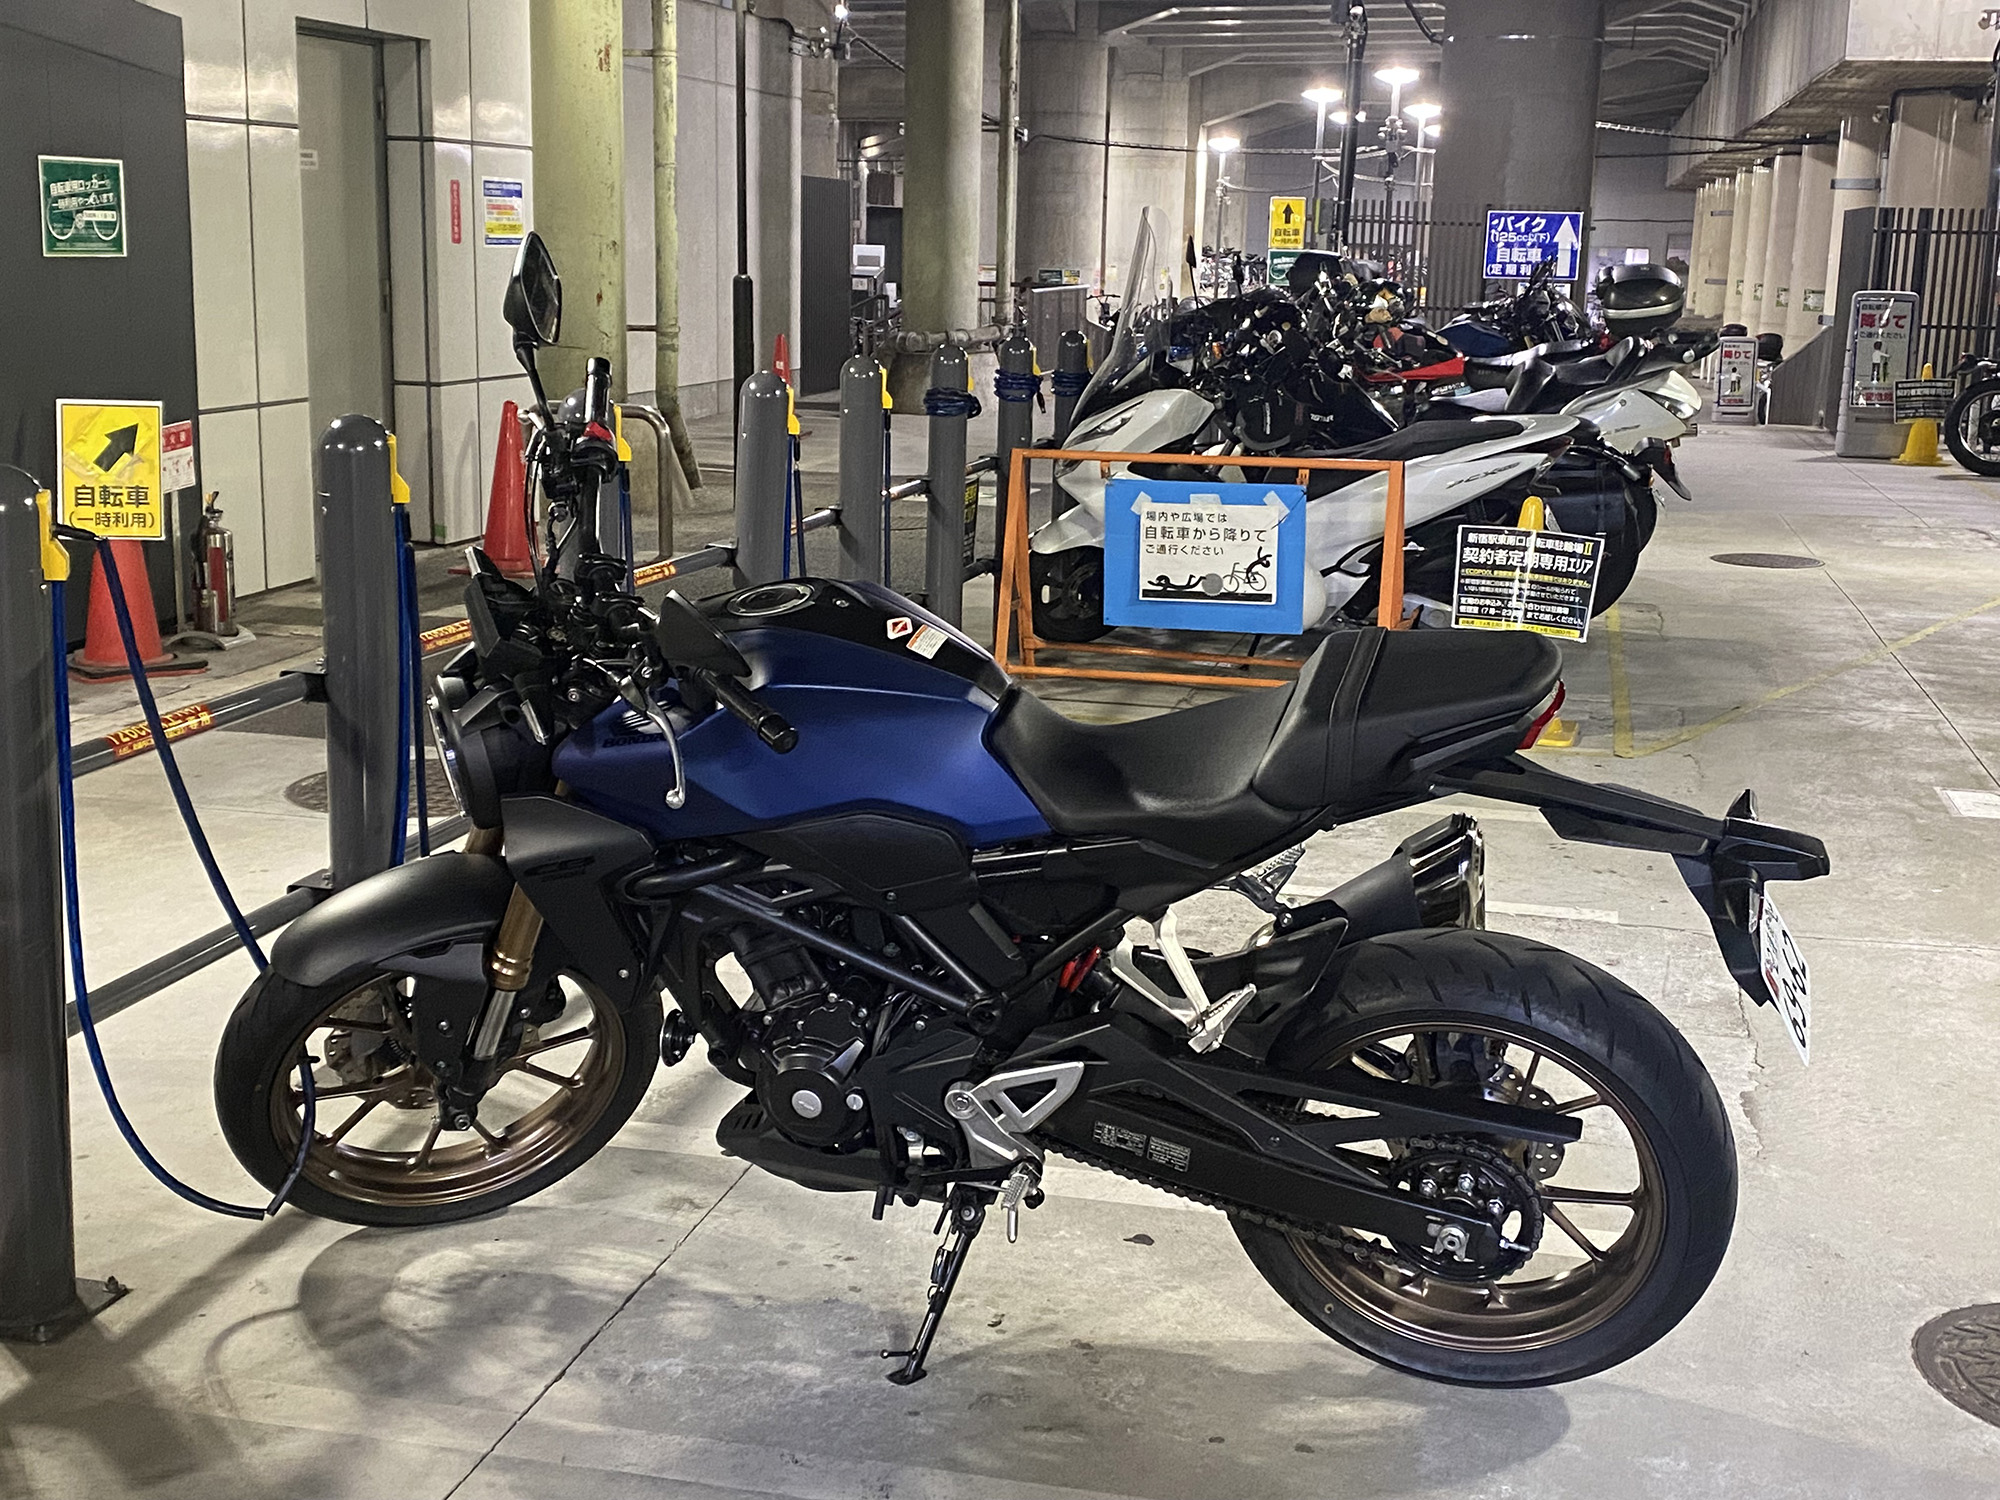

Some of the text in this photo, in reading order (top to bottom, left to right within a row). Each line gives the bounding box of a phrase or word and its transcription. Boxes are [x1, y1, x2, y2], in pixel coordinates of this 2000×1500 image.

[1496, 246, 1542, 263] 自転車
[1861, 313, 1907, 329] 降りて
[74, 485, 150, 508] 自転車
[69, 511, 155, 528] (一時利用)
[1146, 511, 1228, 523] 場内や広場では
[1145, 527, 1267, 543] 自転車から降りて
[1145, 544, 1224, 556] ご通行ください
